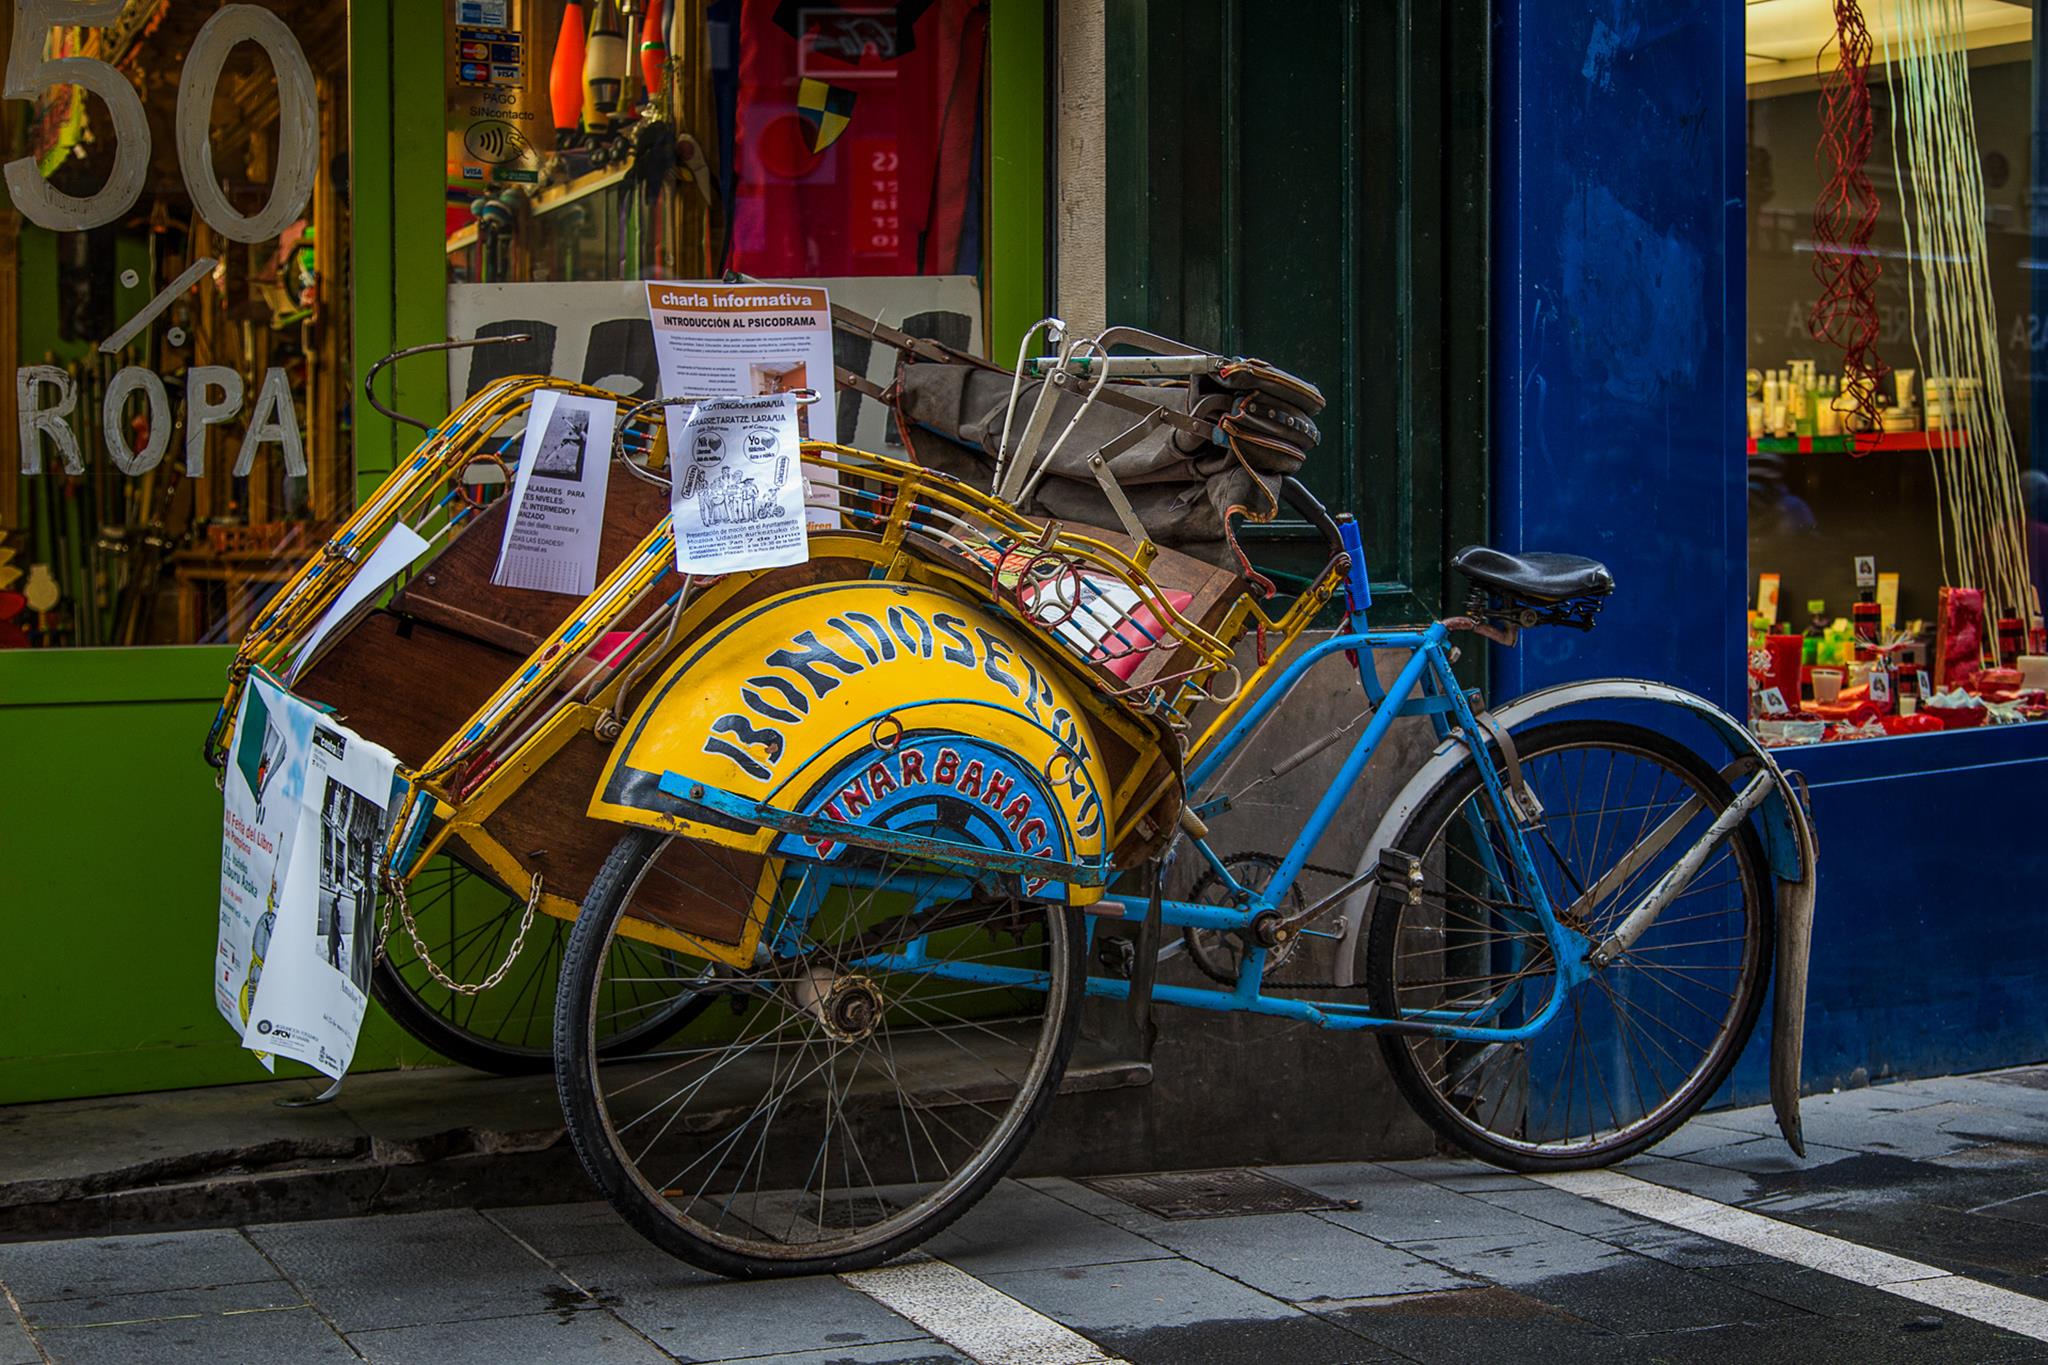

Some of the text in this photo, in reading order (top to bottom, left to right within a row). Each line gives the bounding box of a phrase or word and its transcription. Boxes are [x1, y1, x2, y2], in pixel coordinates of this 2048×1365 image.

[497, 71, 515, 79] VISA
[483, 92, 516, 105] PAGO
[469, 106, 534, 121] SINcontacto
[3, 0, 320, 243] 50
[465, 168, 482, 177] VISA
[661, 292, 812, 307] charla informativa
[98, 258, 218, 355] %
[664, 316, 816, 328] INTRODUCCIÓN AL PSICODRAMA
[16, 365, 308, 477] ROPA
[748, 435, 760, 446] Yo
[536, 495, 565, 505] NIVELES:
[567, 490, 585, 498] PARA
[530, 504, 570, 514] INTERMEDIO
[715, 533, 743, 541] Udalan
[231, 814, 245, 835] Feria
[246, 825, 256, 841] del
[257, 832, 273, 855] Libro
[241, 874, 258, 899] Azoka
